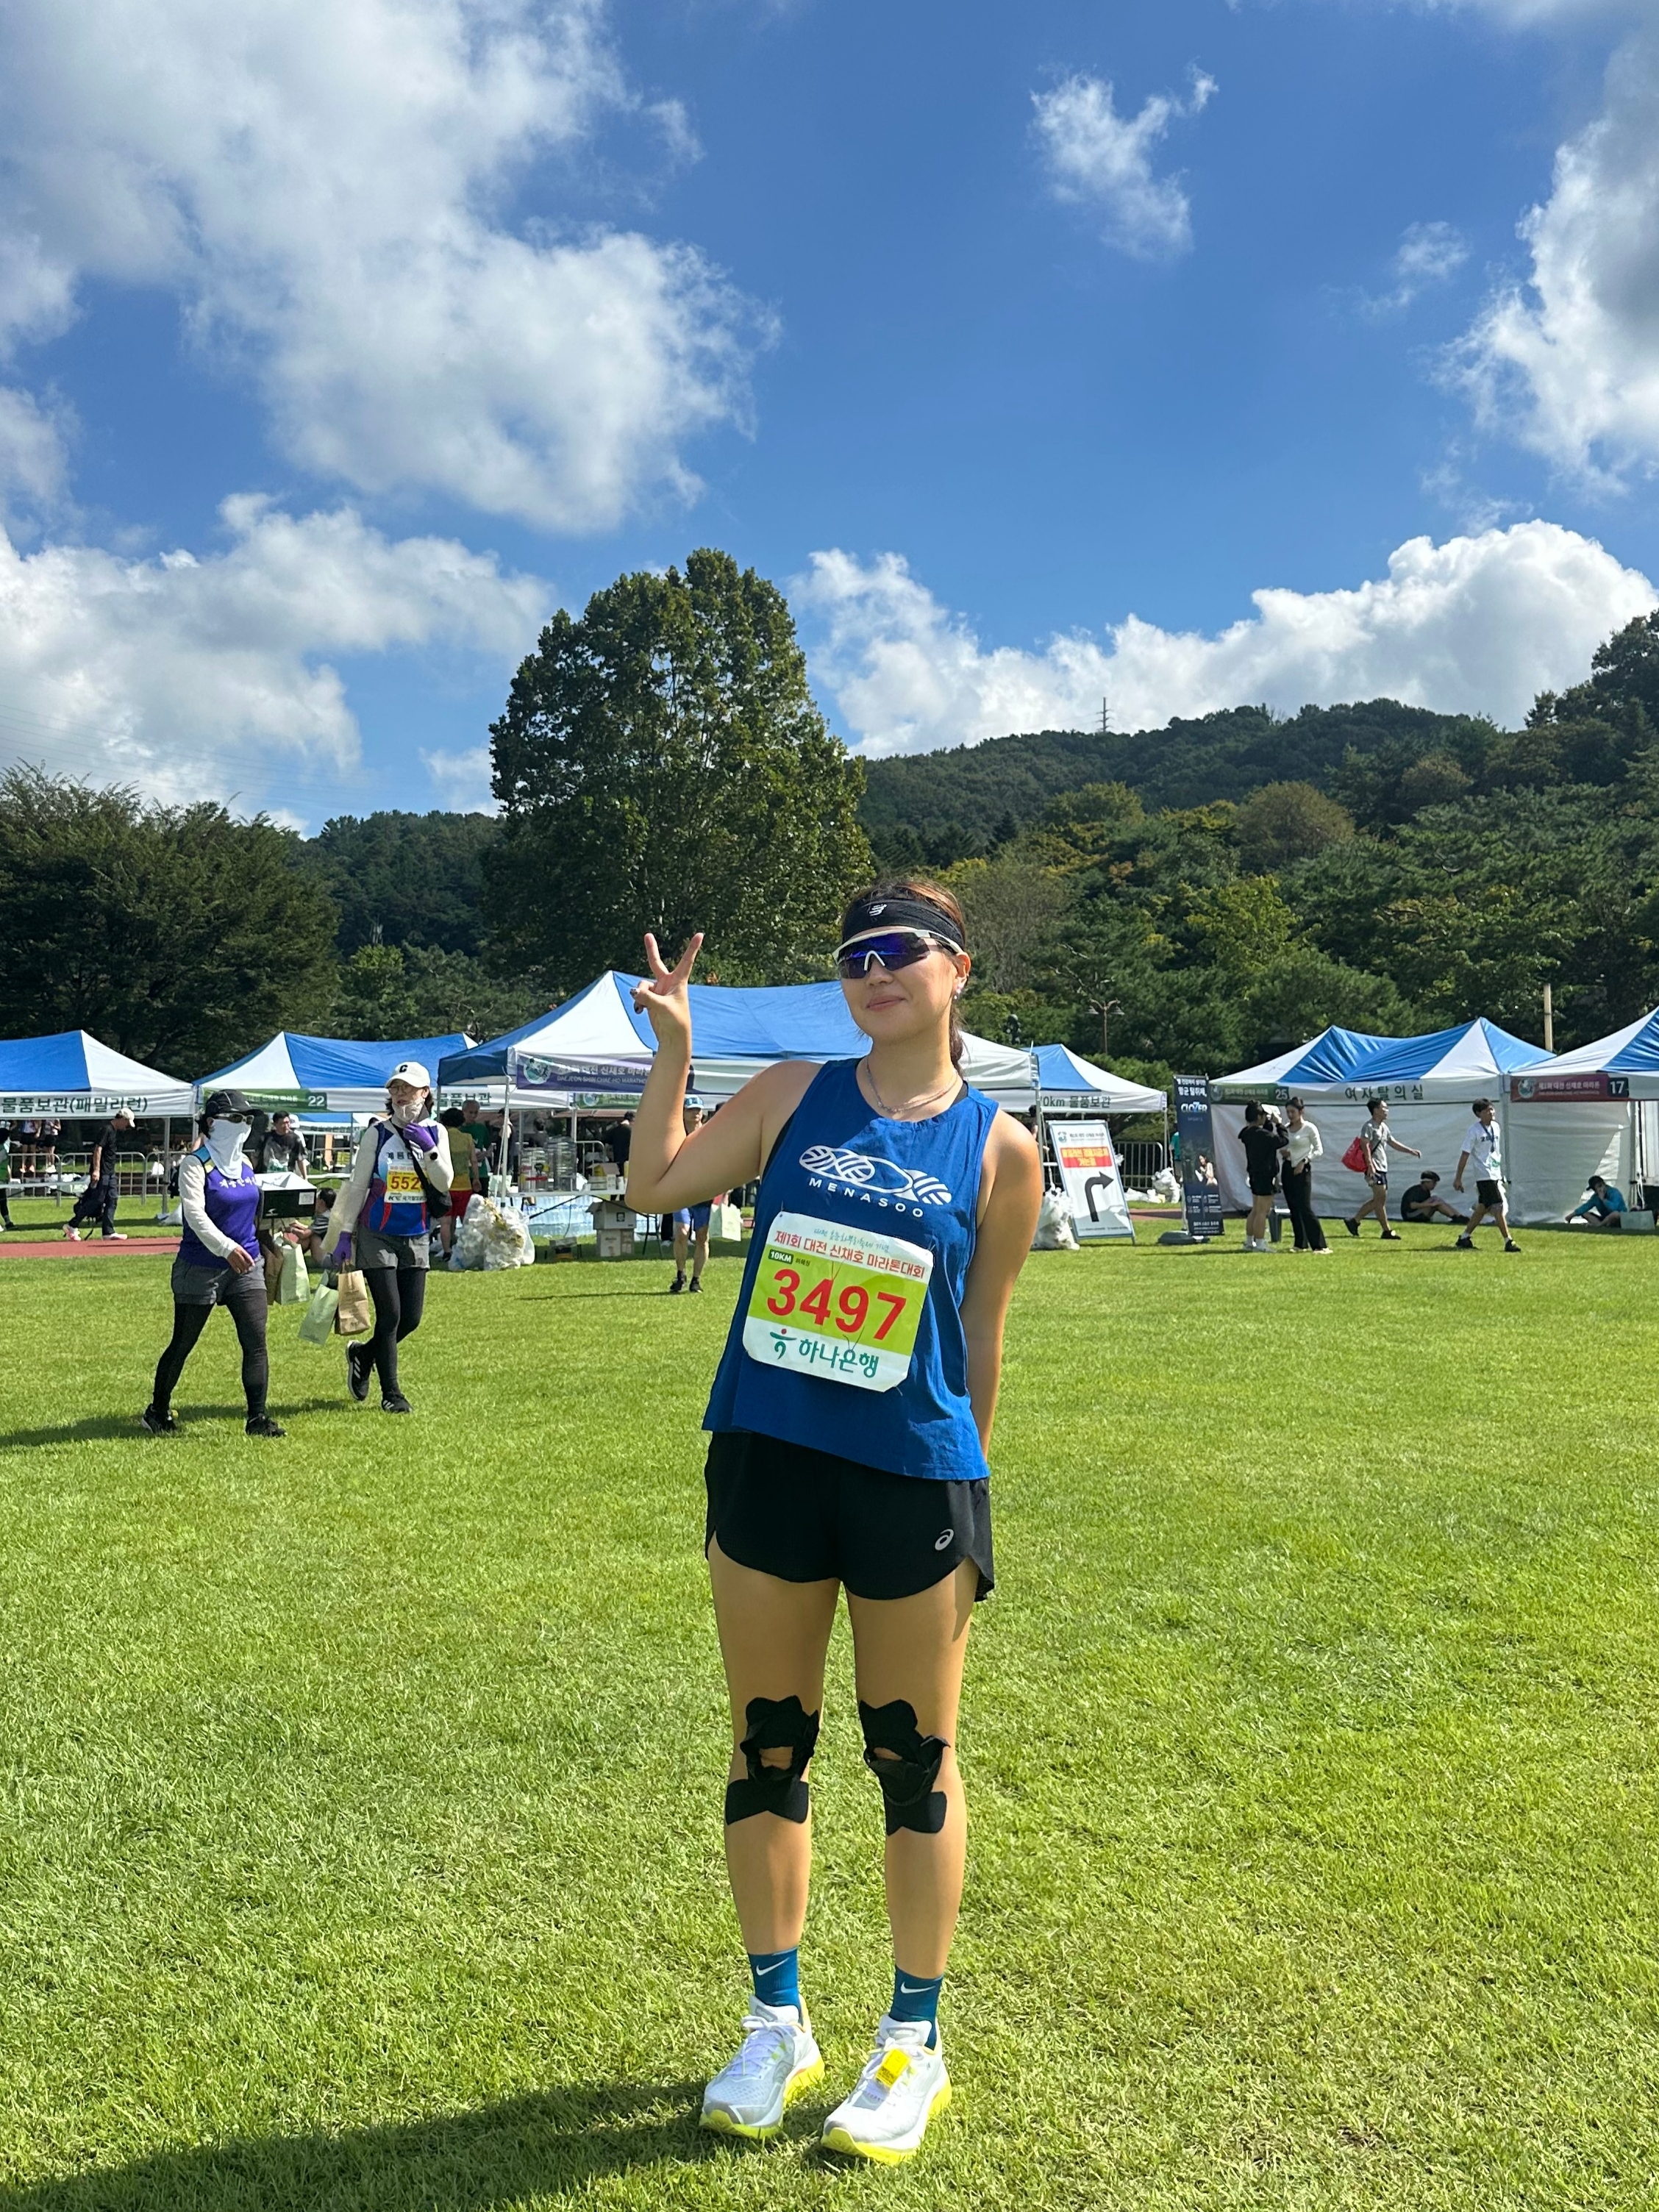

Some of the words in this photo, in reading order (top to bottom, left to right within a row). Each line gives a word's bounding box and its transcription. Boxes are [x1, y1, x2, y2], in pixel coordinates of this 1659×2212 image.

[1275, 1089, 1288, 1100] 25
[1609, 1080, 1624, 1094] 17
[2, 1096, 148, 1113] 물품보관(패밀리런)
[307, 1096, 325, 1107] 22
[1069, 1096, 1111, 1109] 물품보관
[809, 1177, 924, 1218] MENASOO
[770, 1251, 792, 1263] 10KM
[774, 1230, 802, 1249] 제1회
[803, 1238, 828, 1255] 대전
[830, 1244, 865, 1264] 신채호
[867, 1253, 925, 1279] 마라톤대회
[767, 1269, 907, 1341] 3497
[799, 1338, 880, 1378] 하나은행
